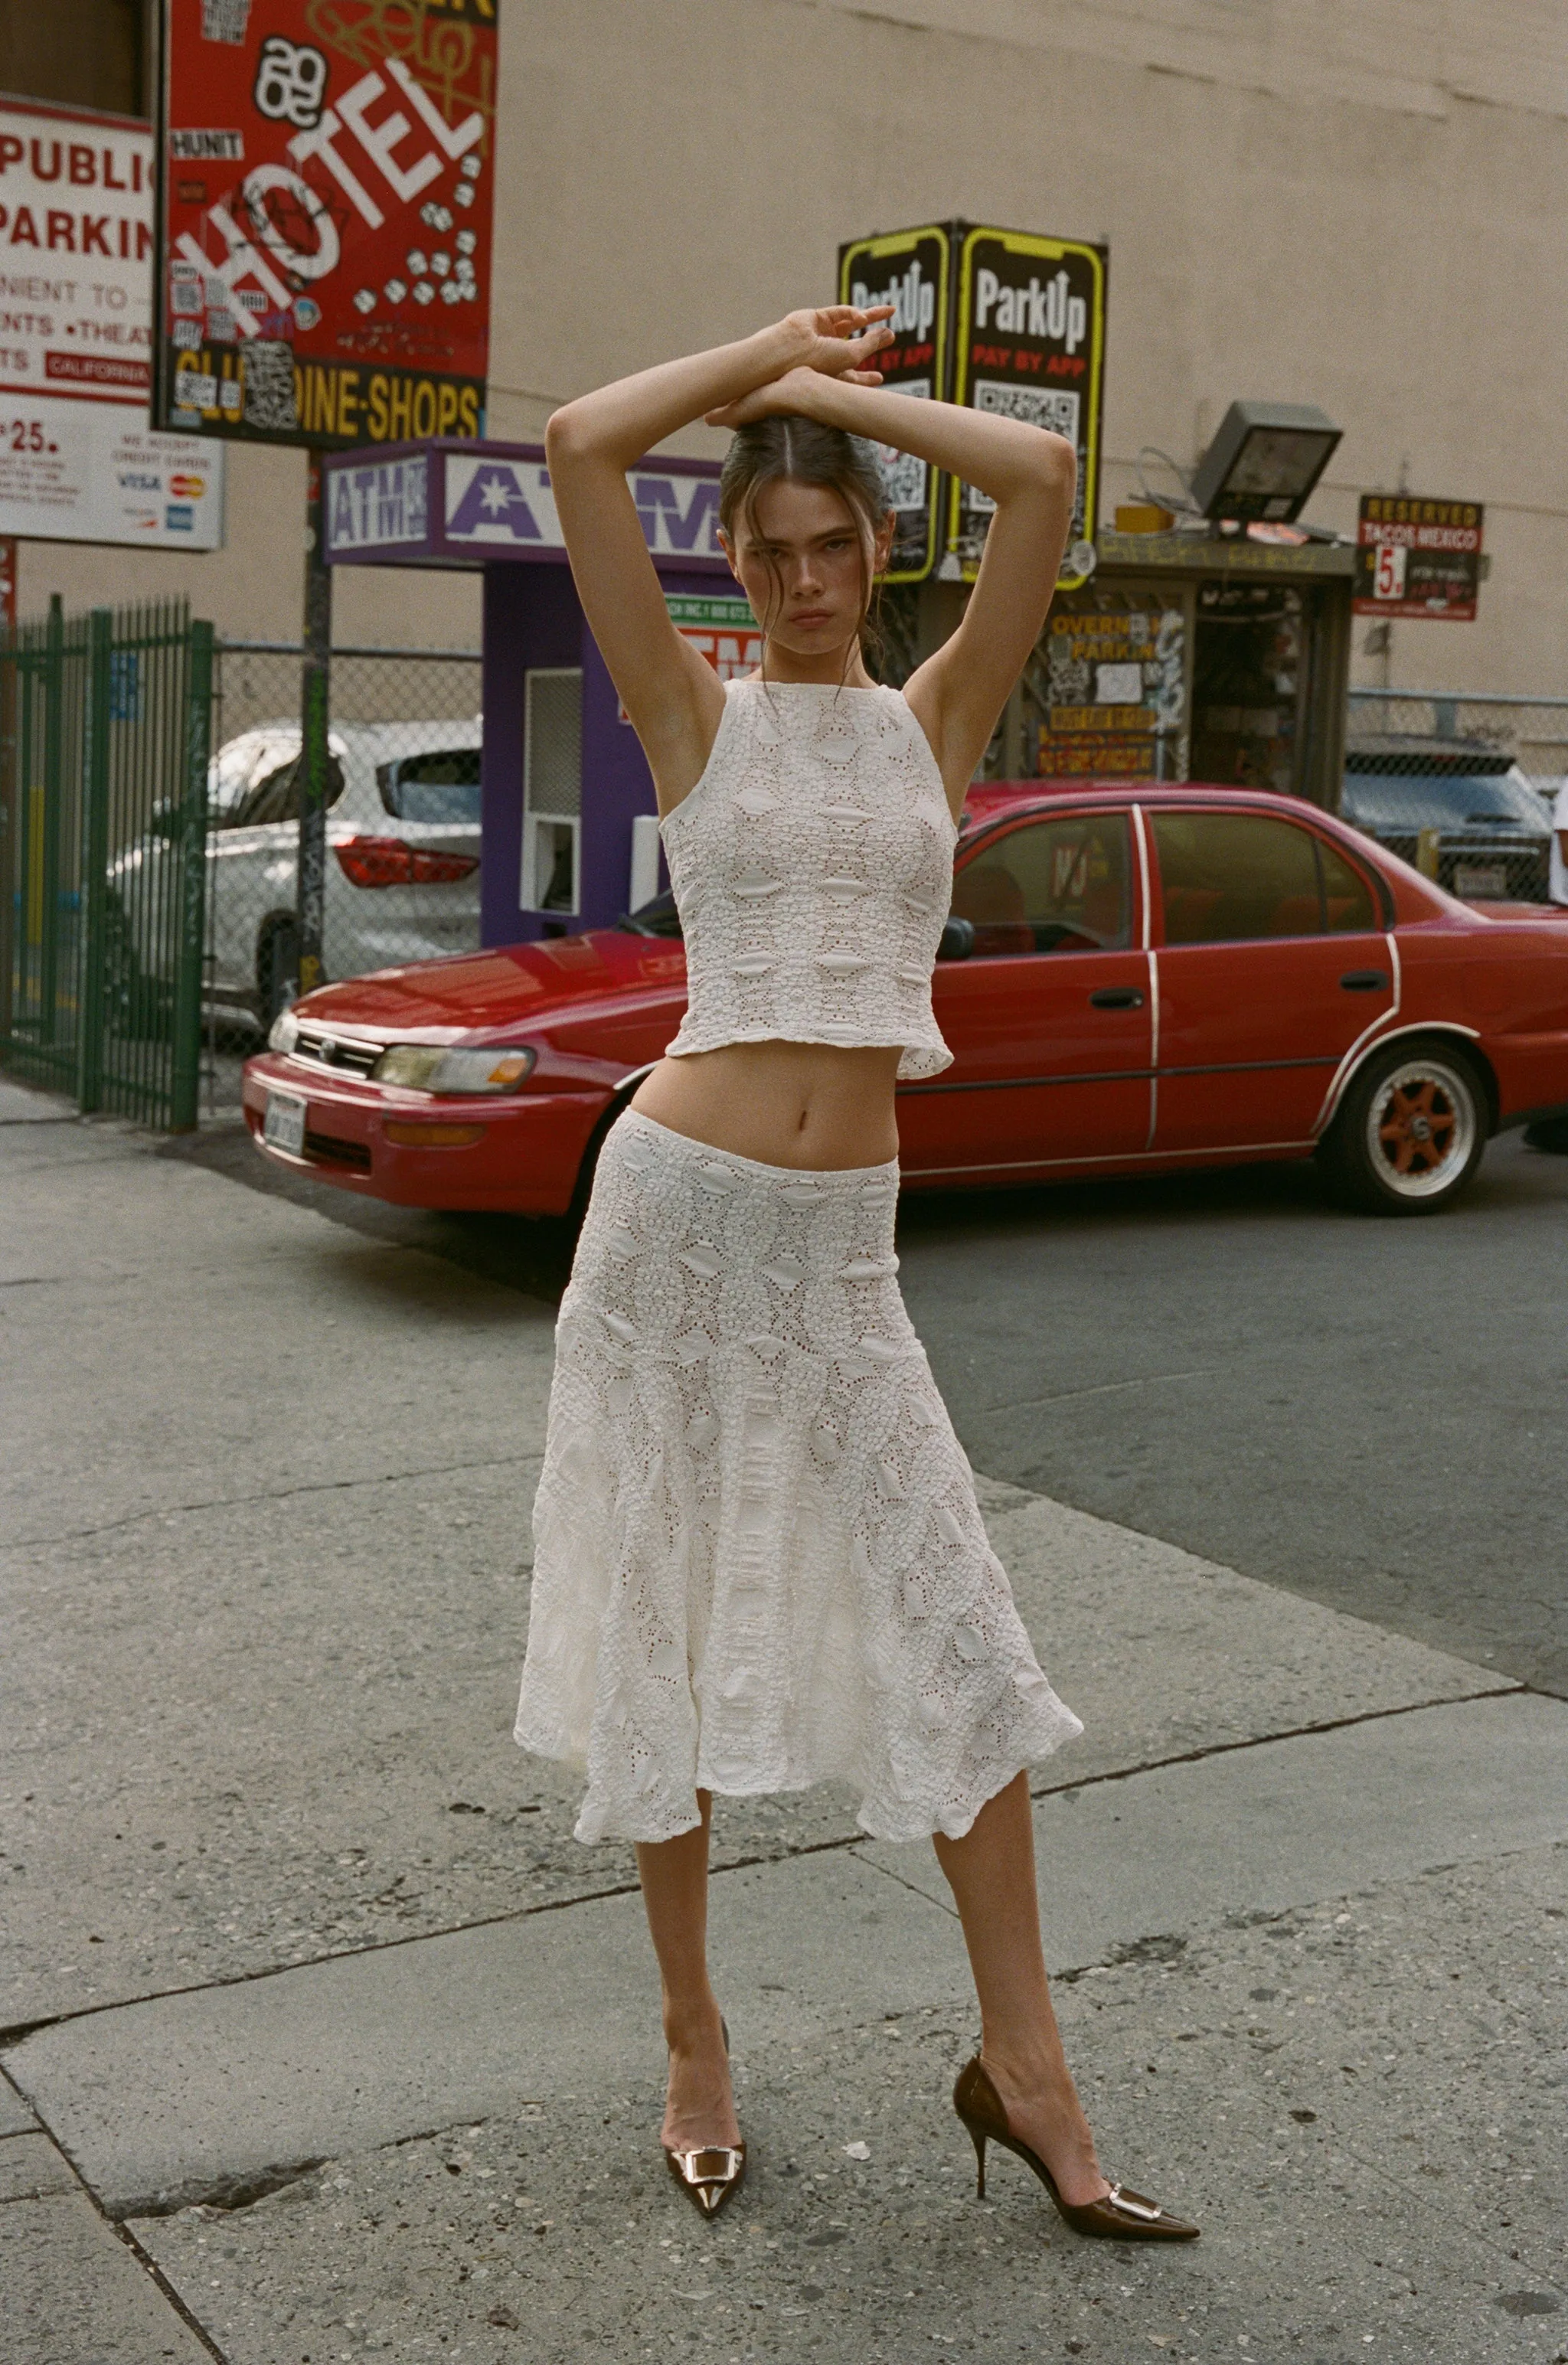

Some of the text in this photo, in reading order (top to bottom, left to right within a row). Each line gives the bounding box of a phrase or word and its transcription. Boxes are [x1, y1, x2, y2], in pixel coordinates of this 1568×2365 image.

[0, 132, 155, 193] PUBLI
[175, 56, 485, 339] HOTEL
[0, 202, 155, 262] ARKIN
[92, 281, 128, 310] TO
[975, 268, 1087, 355] ParkUp
[903, 343, 934, 367] APP
[972, 344, 1086, 380] PAY BY APP
[117, 472, 162, 492] VISA
[333, 464, 403, 543] ATM
[446, 465, 724, 552] AM
[1364, 522, 1479, 551] TACOS MEXICO
[1073, 642, 1156, 661] PARKIN
